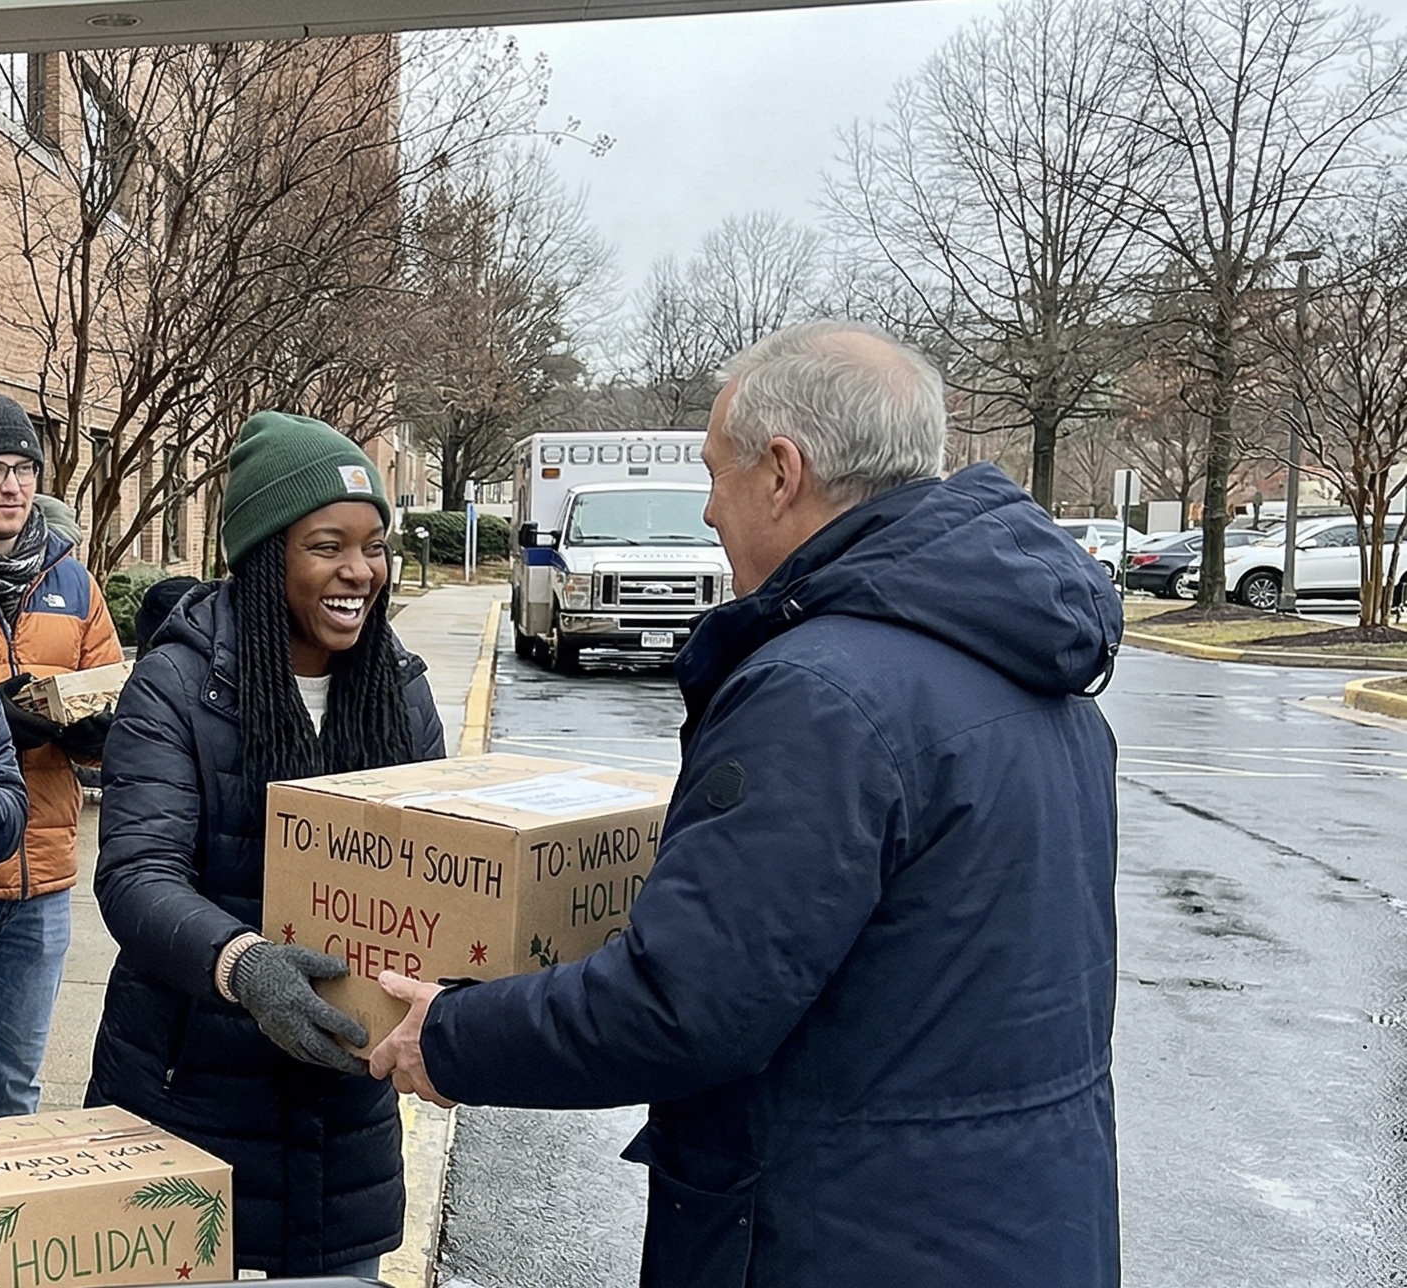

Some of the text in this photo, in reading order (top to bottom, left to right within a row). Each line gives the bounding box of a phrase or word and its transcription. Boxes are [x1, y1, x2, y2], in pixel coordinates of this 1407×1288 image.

[276, 811, 503, 899] TO: WARD 4 SOUTH
[529, 820, 659, 882] TO: WARD 4
[311, 880, 441, 949] HOLIDAY
[28, 1160, 134, 1182] SOUTH
[12, 1219, 176, 1288] HOLIDAY
